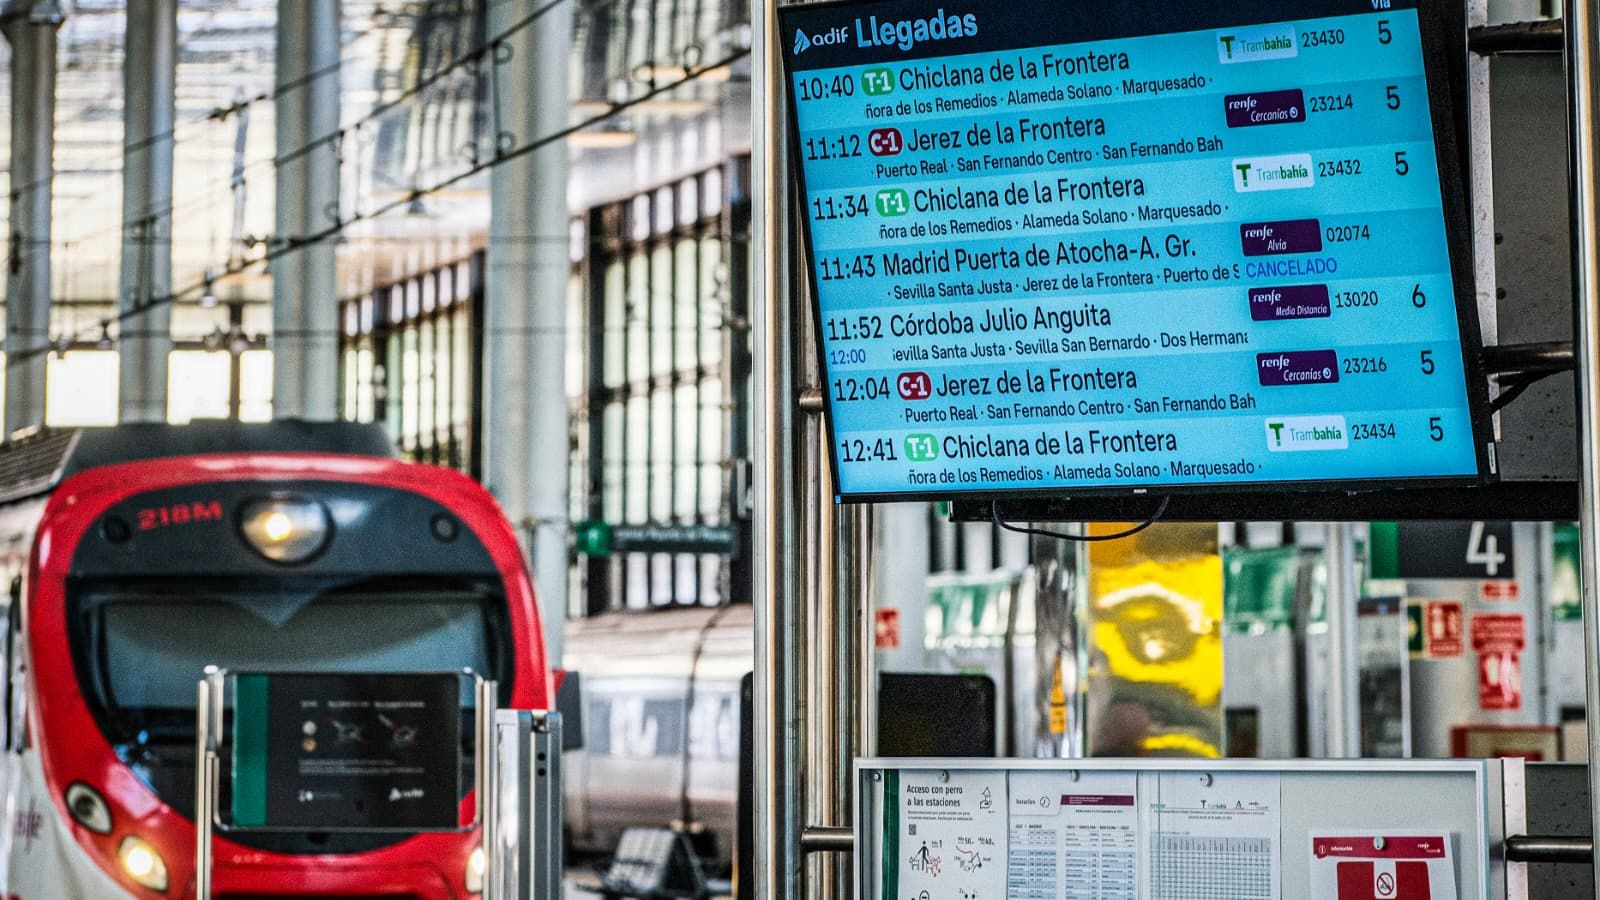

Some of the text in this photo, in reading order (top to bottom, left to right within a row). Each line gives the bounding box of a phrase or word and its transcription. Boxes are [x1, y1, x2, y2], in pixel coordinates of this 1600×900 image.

[813, 27, 848, 45] adif
[856, 8, 977, 50] Llegadas
[1302, 29, 1344, 47] 23430
[1378, 20, 1392, 44] 5
[800, 51, 1129, 101] 10:40 T-1 Chiclana de la Frontera
[896, 100, 911, 115] de
[914, 99, 932, 114] los
[936, 94, 997, 112] Remedios
[1008, 86, 1064, 105] Alameda
[1067, 83, 1112, 99] Solano
[1122, 73, 1206, 95] Marquesado
[1230, 96, 1256, 111] renfe
[1310, 94, 1353, 112] 23214
[1386, 86, 1400, 110] 5
[806, 116, 1105, 160] 11:12 C-1 Jerez de la Frontera
[876, 136, 1223, 178] Puerto Real San Fernando Centro San Fernando Bah
[1318, 160, 1361, 177] 23432
[1395, 152, 1408, 176] 5
[813, 176, 1144, 220] 11:34 T-1 Chiclana de la Frontera
[910, 222, 925, 237] de
[928, 221, 947, 236] los
[950, 217, 1012, 234] Remedios
[1023, 211, 1079, 229] Alameda
[1082, 208, 1127, 224] Solano
[1138, 200, 1221, 222] Marquesado
[1246, 226, 1272, 240] renfe
[1268, 239, 1286, 250] Alvia
[1327, 225, 1370, 242] 02074
[820, 234, 1195, 280] 11:43 Madrid Puerta de Atocha-A. Gr.
[1246, 258, 1337, 278] CANCELADO
[894, 284, 935, 299] Sevilla
[938, 282, 974, 297] Santa
[978, 280, 1012, 294] Justa
[1023, 277, 1059, 292] Jerez
[1062, 274, 1078, 289] de
[1081, 273, 1094, 288] la
[1097, 272, 1153, 287] Frontera
[1164, 267, 1208, 283] Puerto
[1212, 264, 1229, 280] de
[1254, 290, 1281, 304] renfe
[1335, 290, 1378, 308] 13020
[1412, 284, 1426, 308] 6
[828, 304, 1111, 341] 11:52 Córdoba Julio Anguita
[831, 349, 866, 364] 12:00
[893, 346, 928, 361] evilla
[932, 344, 967, 359] Santa
[971, 343, 1005, 357] Justa
[1016, 338, 1058, 355] Sevilla
[1062, 338, 1086, 352] San
[1089, 334, 1150, 351] Bernardo
[1160, 333, 1186, 348] Dos
[1262, 355, 1289, 370] renfe
[1344, 357, 1387, 374] 23216
[1421, 350, 1434, 374] 5
[834, 368, 1136, 401] 12:04 C-1 Jerez de la Frontera
[906, 393, 1256, 422] Puerto Real San Fernando Centro San Fernando Bah
[1352, 424, 1396, 440] 23434
[1430, 417, 1443, 441] 5
[841, 430, 1177, 462] 12:41 T-1 Chiclana de la Frontera
[940, 468, 955, 483] de
[958, 468, 977, 483] los
[980, 466, 1043, 482] Remedios
[1054, 464, 1111, 480] Alameda
[1114, 462, 1160, 478] Solano
[1170, 458, 1254, 479] Marquesado
[139, 501, 223, 530] 218M
[1466, 522, 1505, 576] 4
[907, 785, 963, 795] Acceso con perro
[907, 797, 960, 807] a las estaciones
